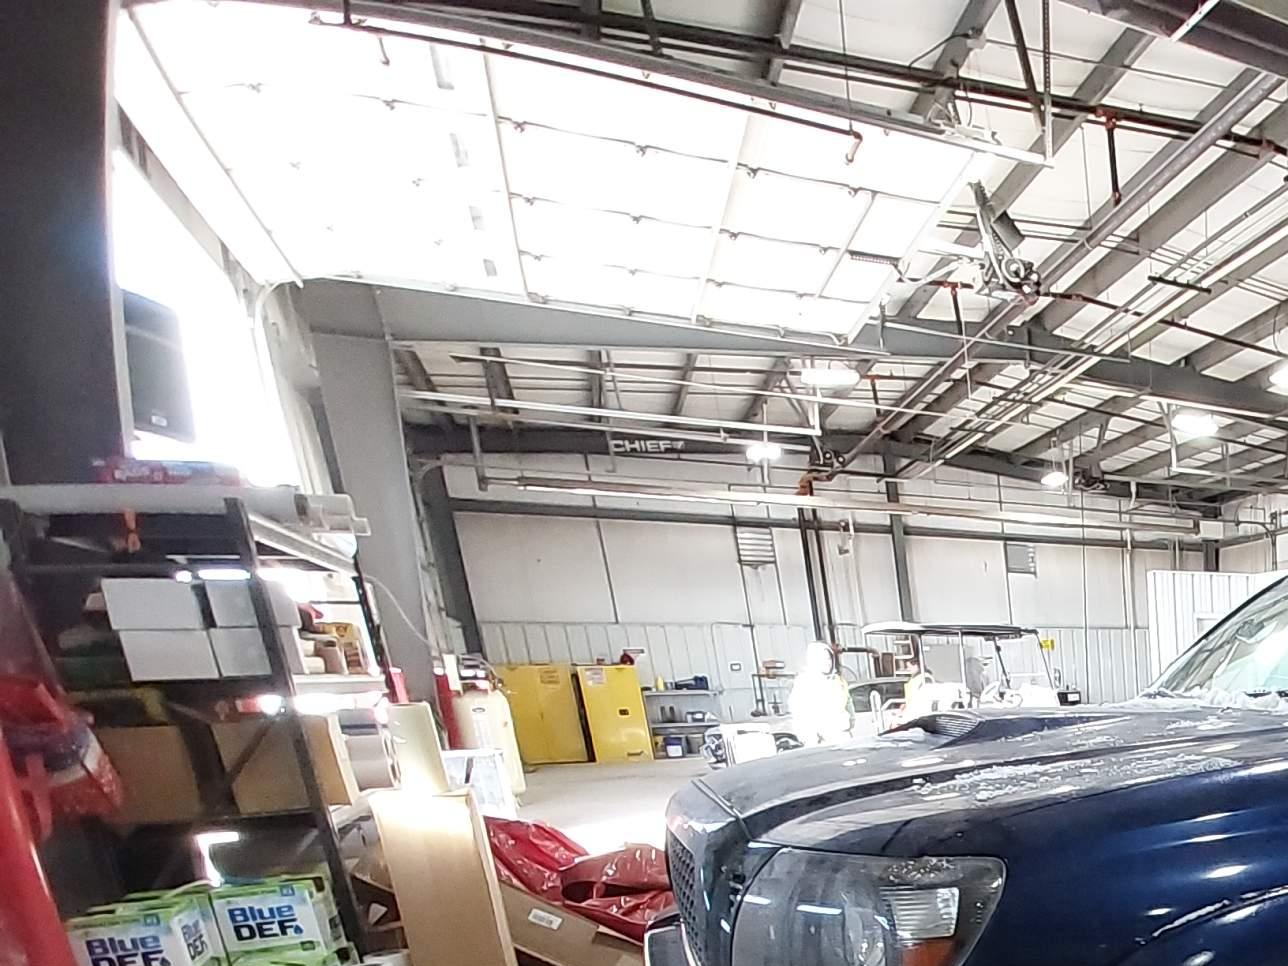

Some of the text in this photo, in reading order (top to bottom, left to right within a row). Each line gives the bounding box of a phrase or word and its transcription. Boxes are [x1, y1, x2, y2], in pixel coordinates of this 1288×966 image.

[611, 440, 672, 453] CHIEF
[227, 904, 296, 924] Blue
[233, 918, 297, 941] DEF
[85, 935, 162, 957] Blue
